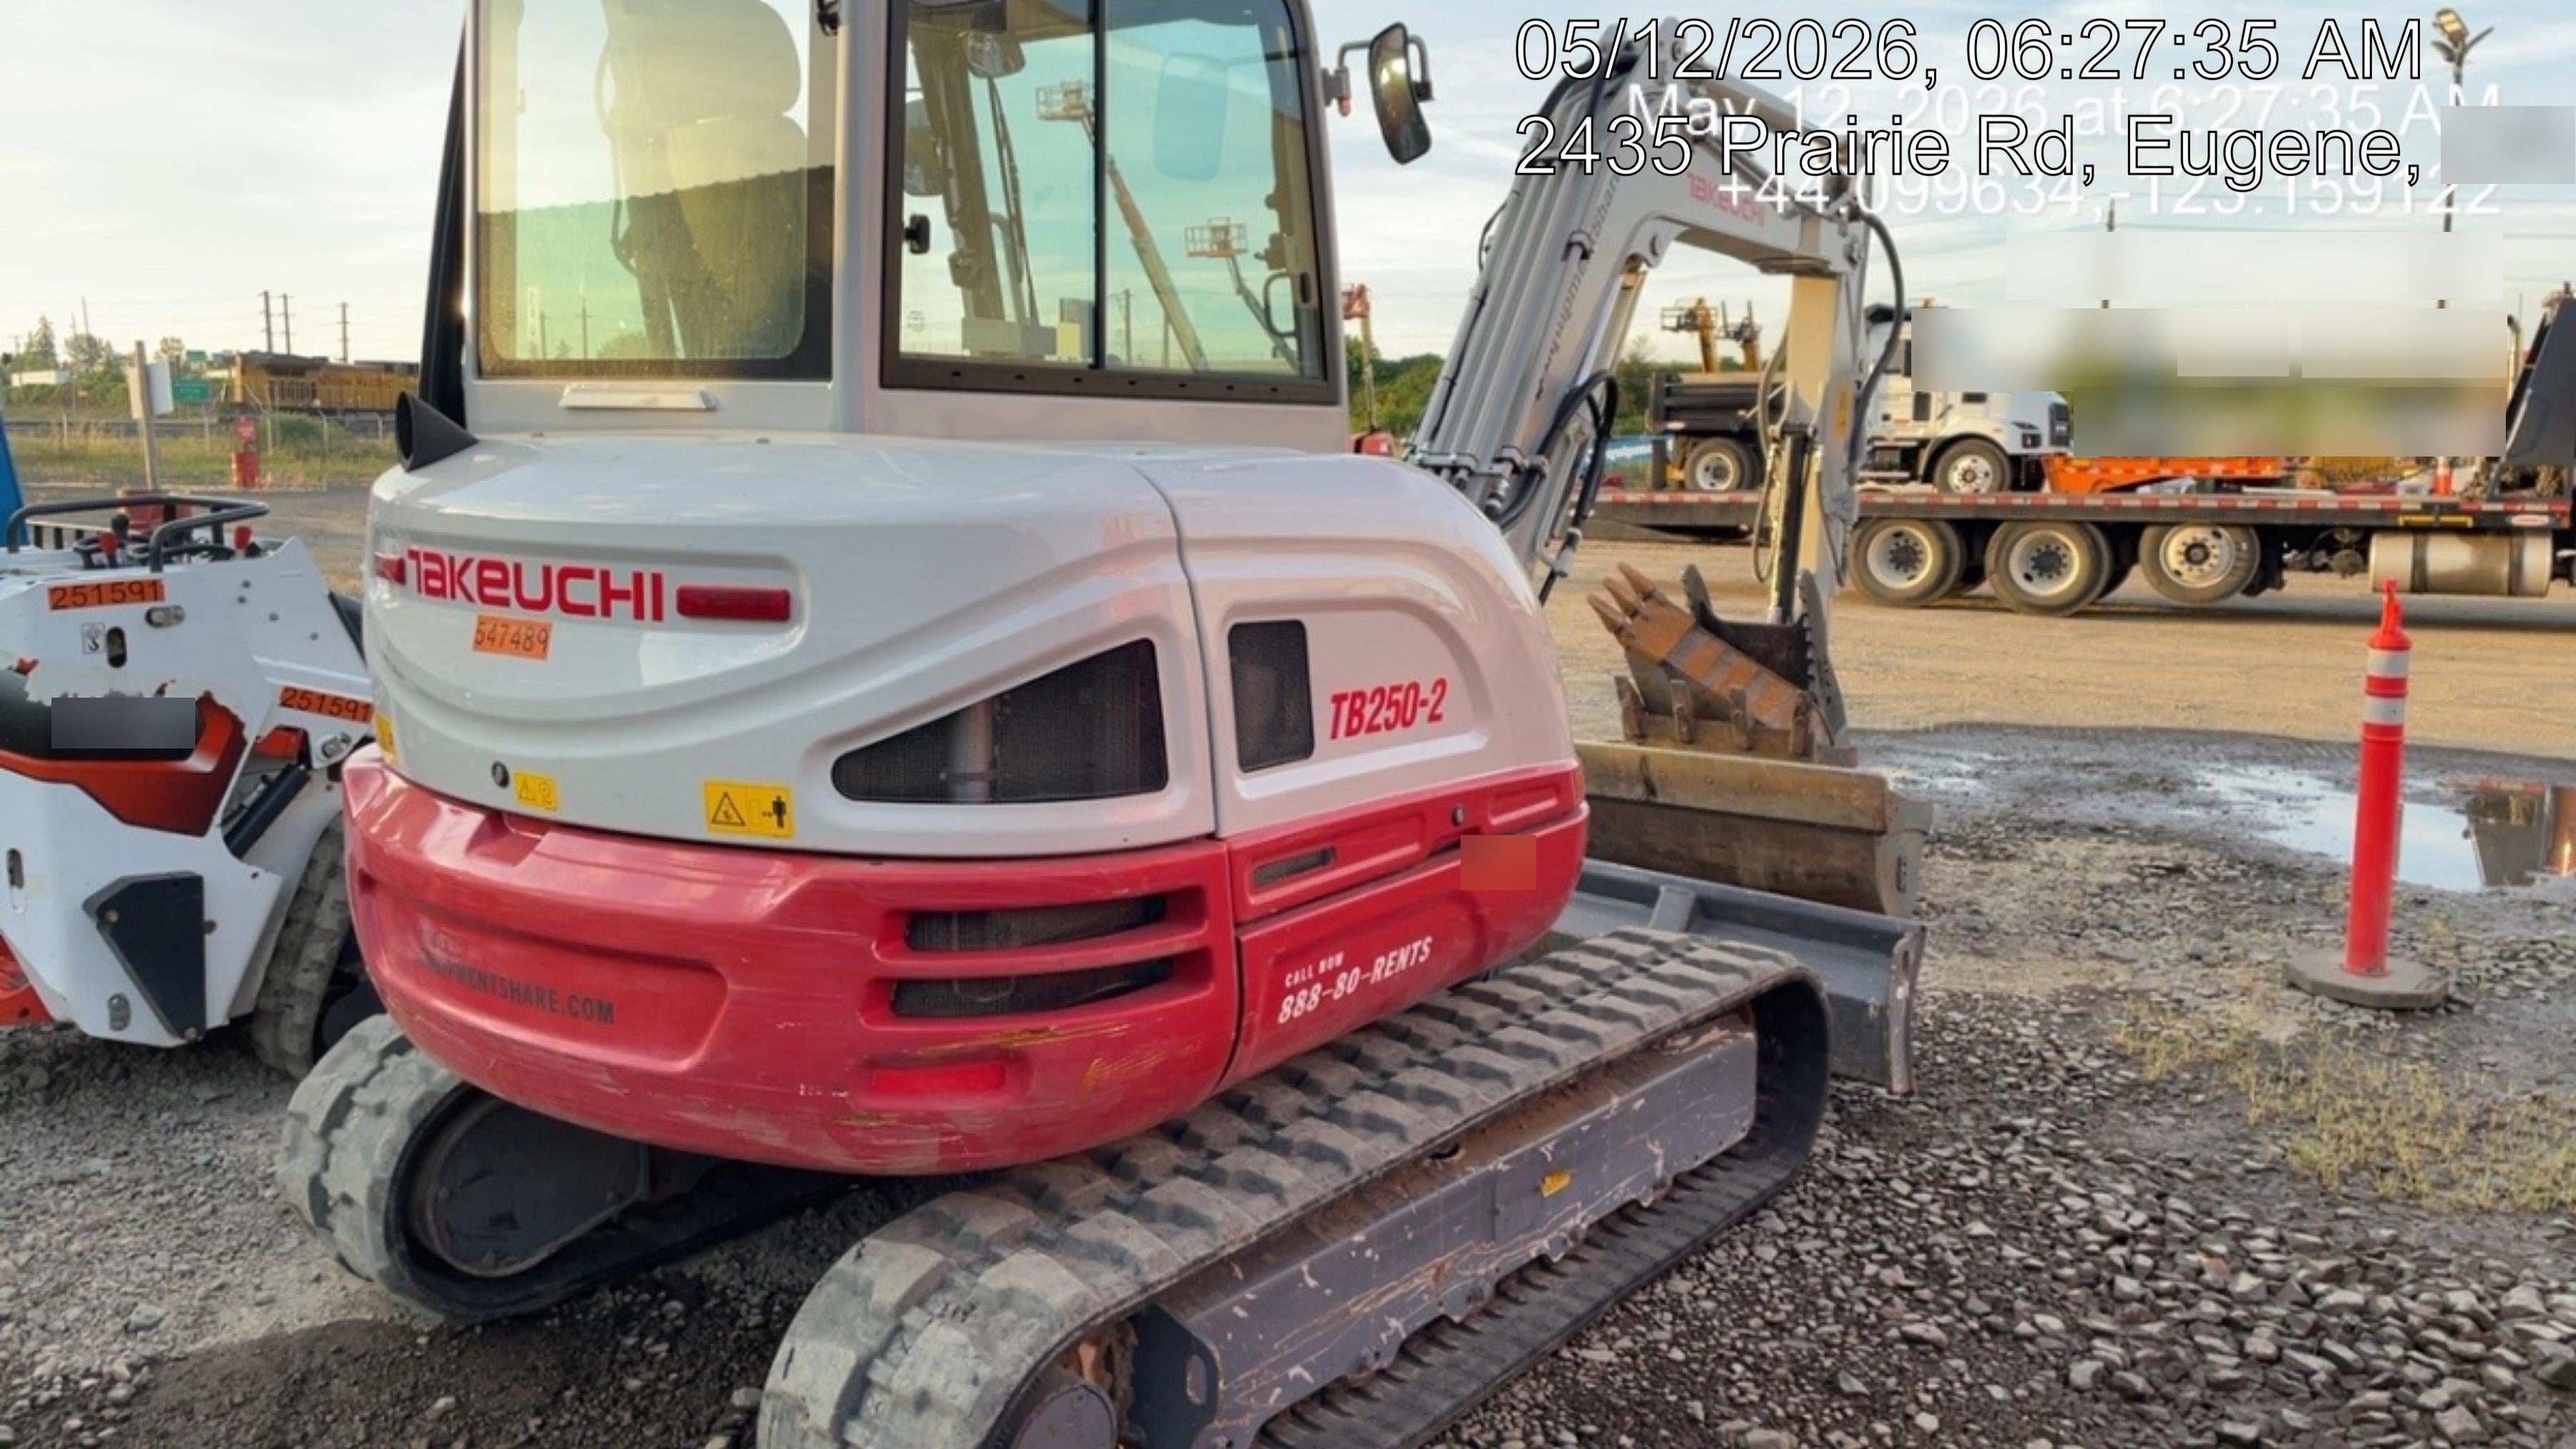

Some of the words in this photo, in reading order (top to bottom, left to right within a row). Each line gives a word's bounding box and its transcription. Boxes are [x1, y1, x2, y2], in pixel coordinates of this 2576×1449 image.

[50, 578, 159, 610] 251591
[475, 621, 548, 654] 547489
[279, 686, 371, 722] 251591
[1329, 678, 1448, 740] TB250-2
[1278, 935, 1433, 1025] 888-80-RENTS
[1285, 964, 1314, 989] CALL
